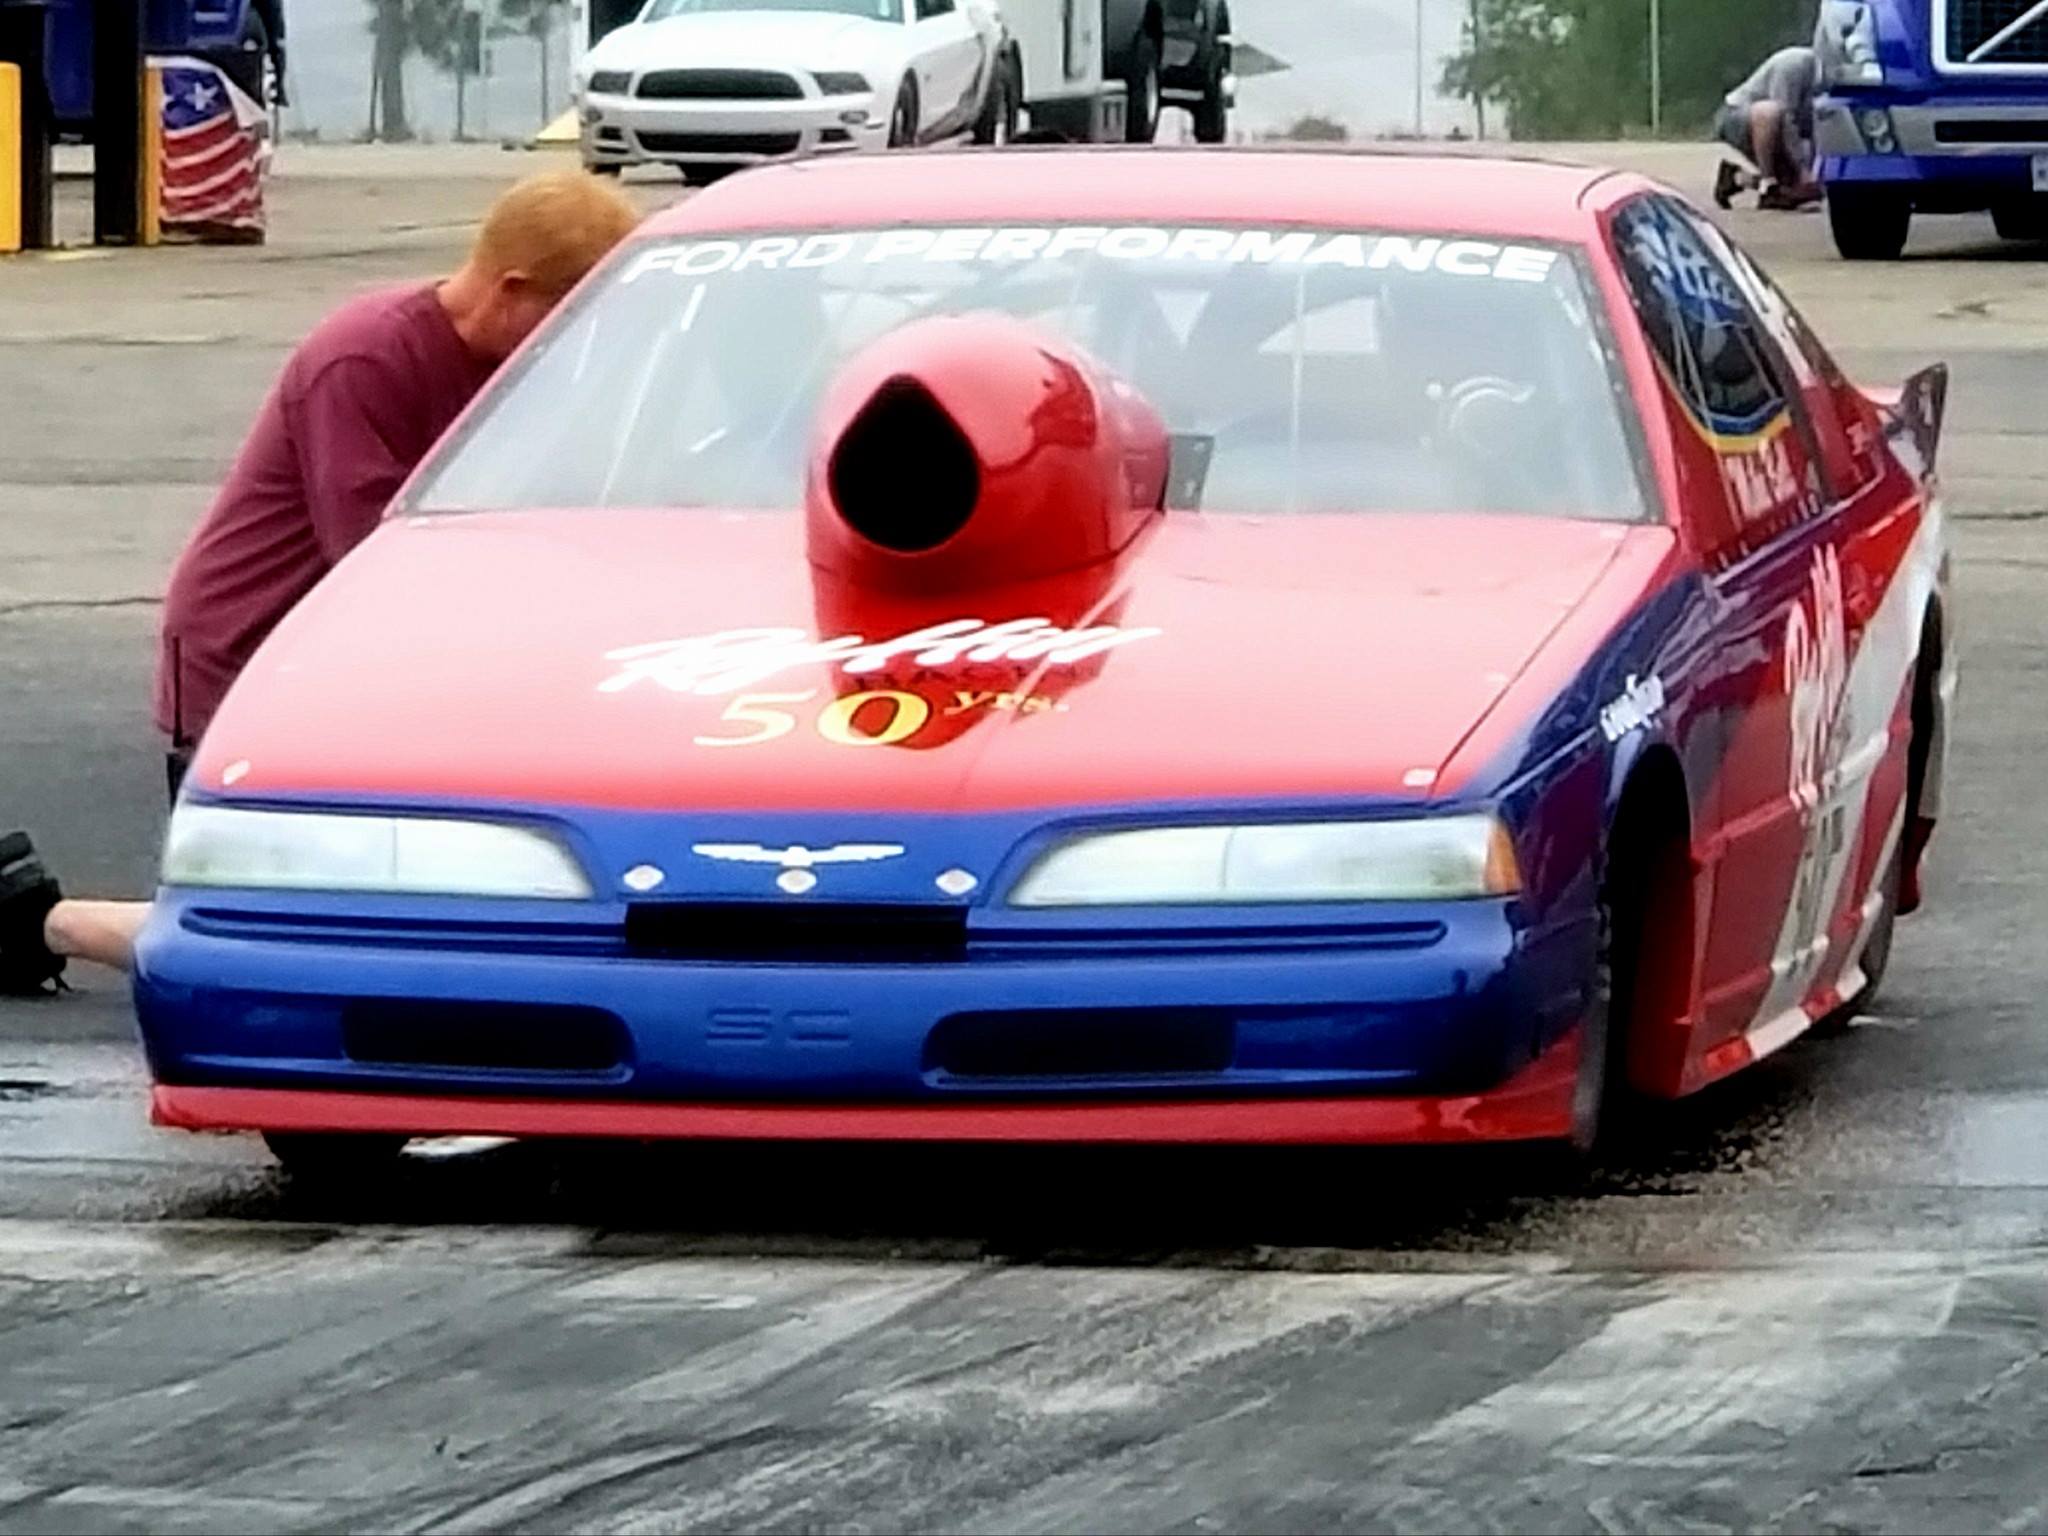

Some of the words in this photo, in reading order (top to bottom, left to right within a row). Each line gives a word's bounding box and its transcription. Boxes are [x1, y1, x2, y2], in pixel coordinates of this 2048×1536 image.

[621, 233, 855, 284] FORD
[864, 227, 1557, 283] PERFORMANCE
[692, 689, 930, 747] 50
[704, 1004, 850, 1047] SC
